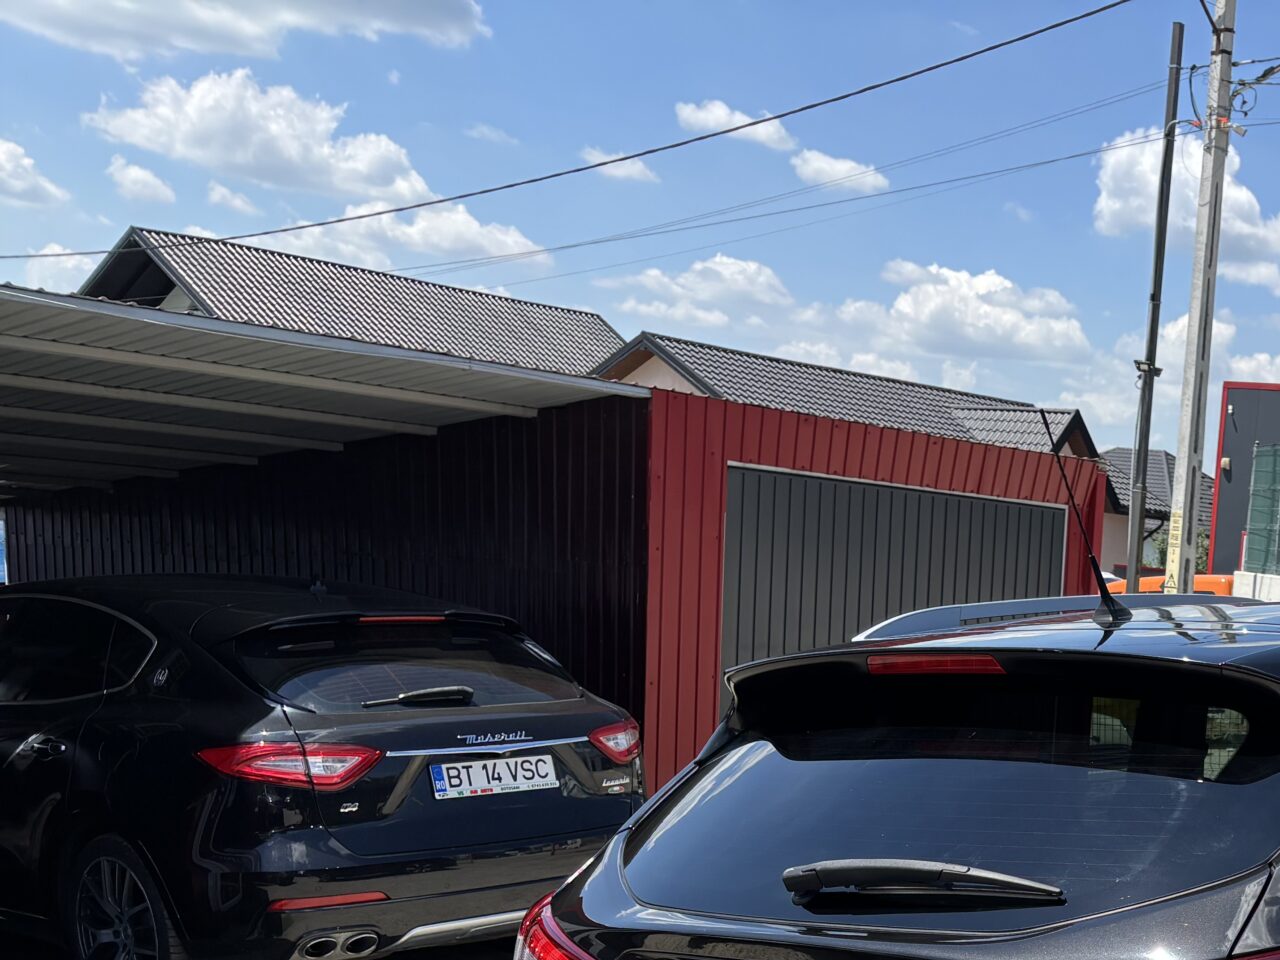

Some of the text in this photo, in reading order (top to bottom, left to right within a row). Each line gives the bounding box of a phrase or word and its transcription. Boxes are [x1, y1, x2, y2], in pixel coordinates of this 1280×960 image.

[445, 758, 549, 788] BT 14 VSC
